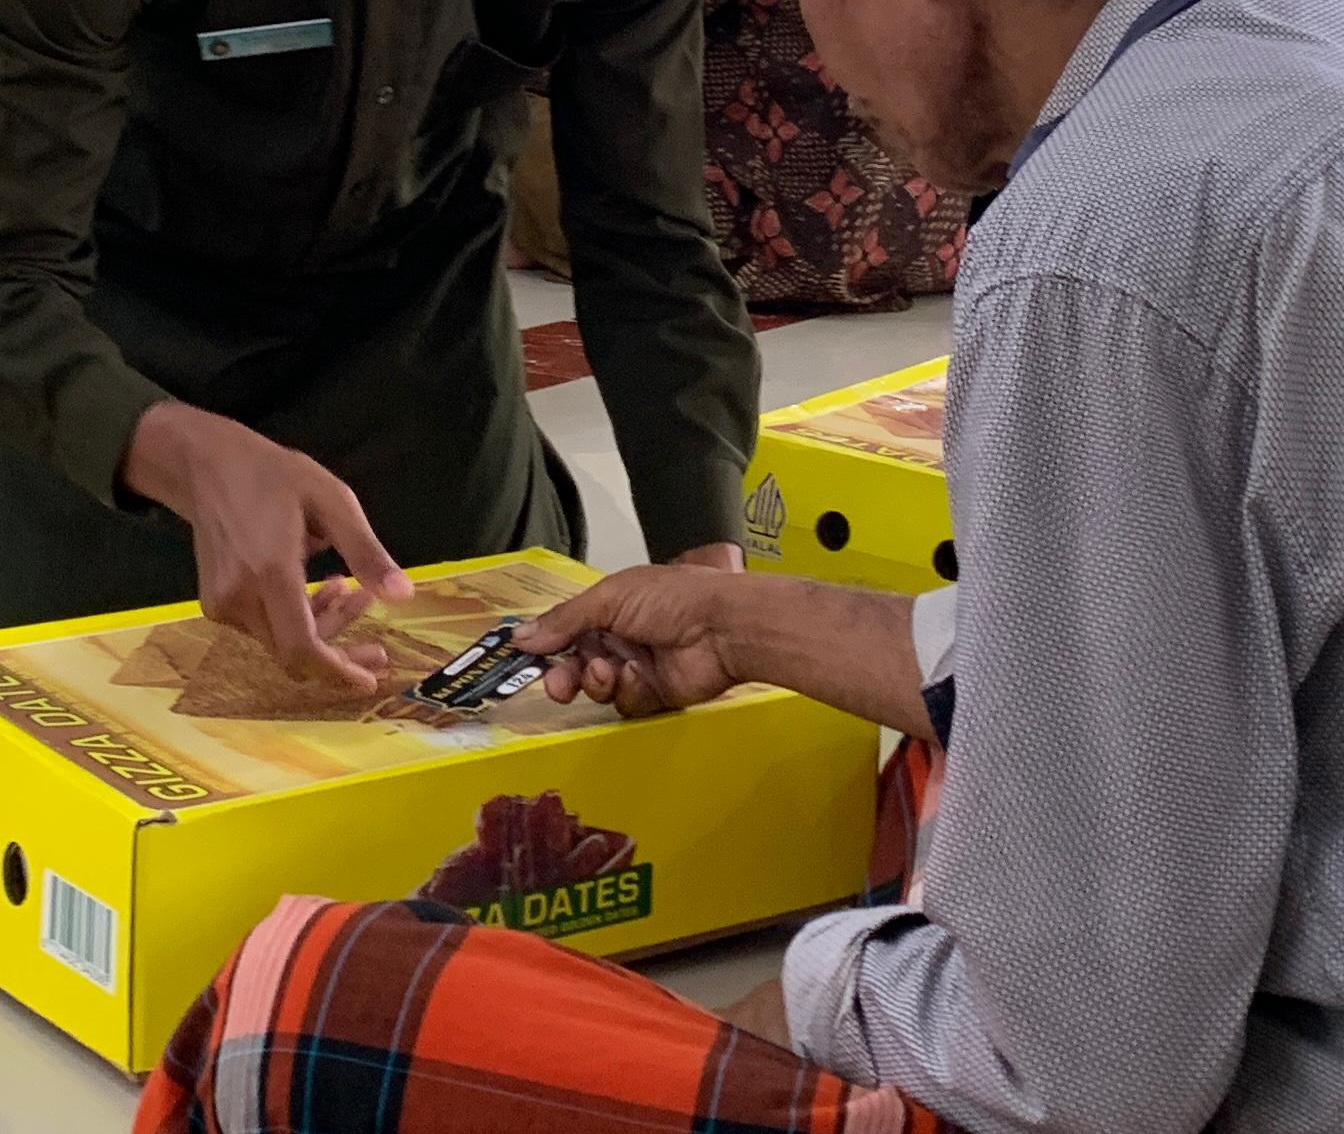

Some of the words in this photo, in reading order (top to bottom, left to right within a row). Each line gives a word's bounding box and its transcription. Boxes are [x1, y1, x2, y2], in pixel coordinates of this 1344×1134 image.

[506, 672, 535, 689] 124
[70, 734, 209, 801] GIZZA
[522, 871, 640, 927] DATES
